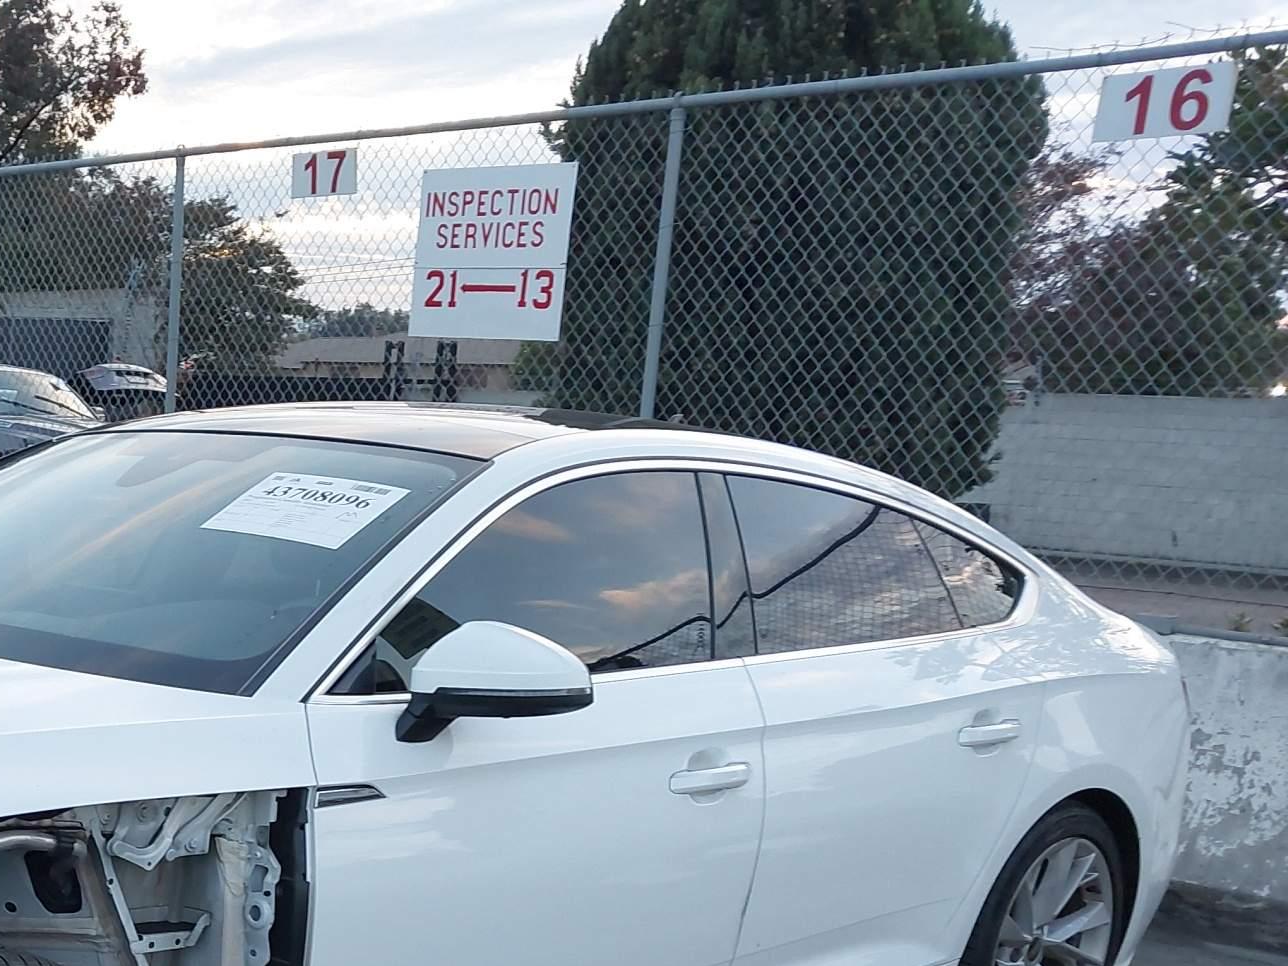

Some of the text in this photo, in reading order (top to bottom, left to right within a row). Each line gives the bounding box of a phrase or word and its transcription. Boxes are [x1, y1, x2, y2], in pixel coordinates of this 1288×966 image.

[1125, 68, 1213, 135] 16
[304, 149, 346, 195] 17
[425, 187, 560, 218] INSPECTION
[435, 220, 545, 249] SERVICES
[423, 268, 554, 310] 21 13
[263, 485, 374, 509] 43708096
